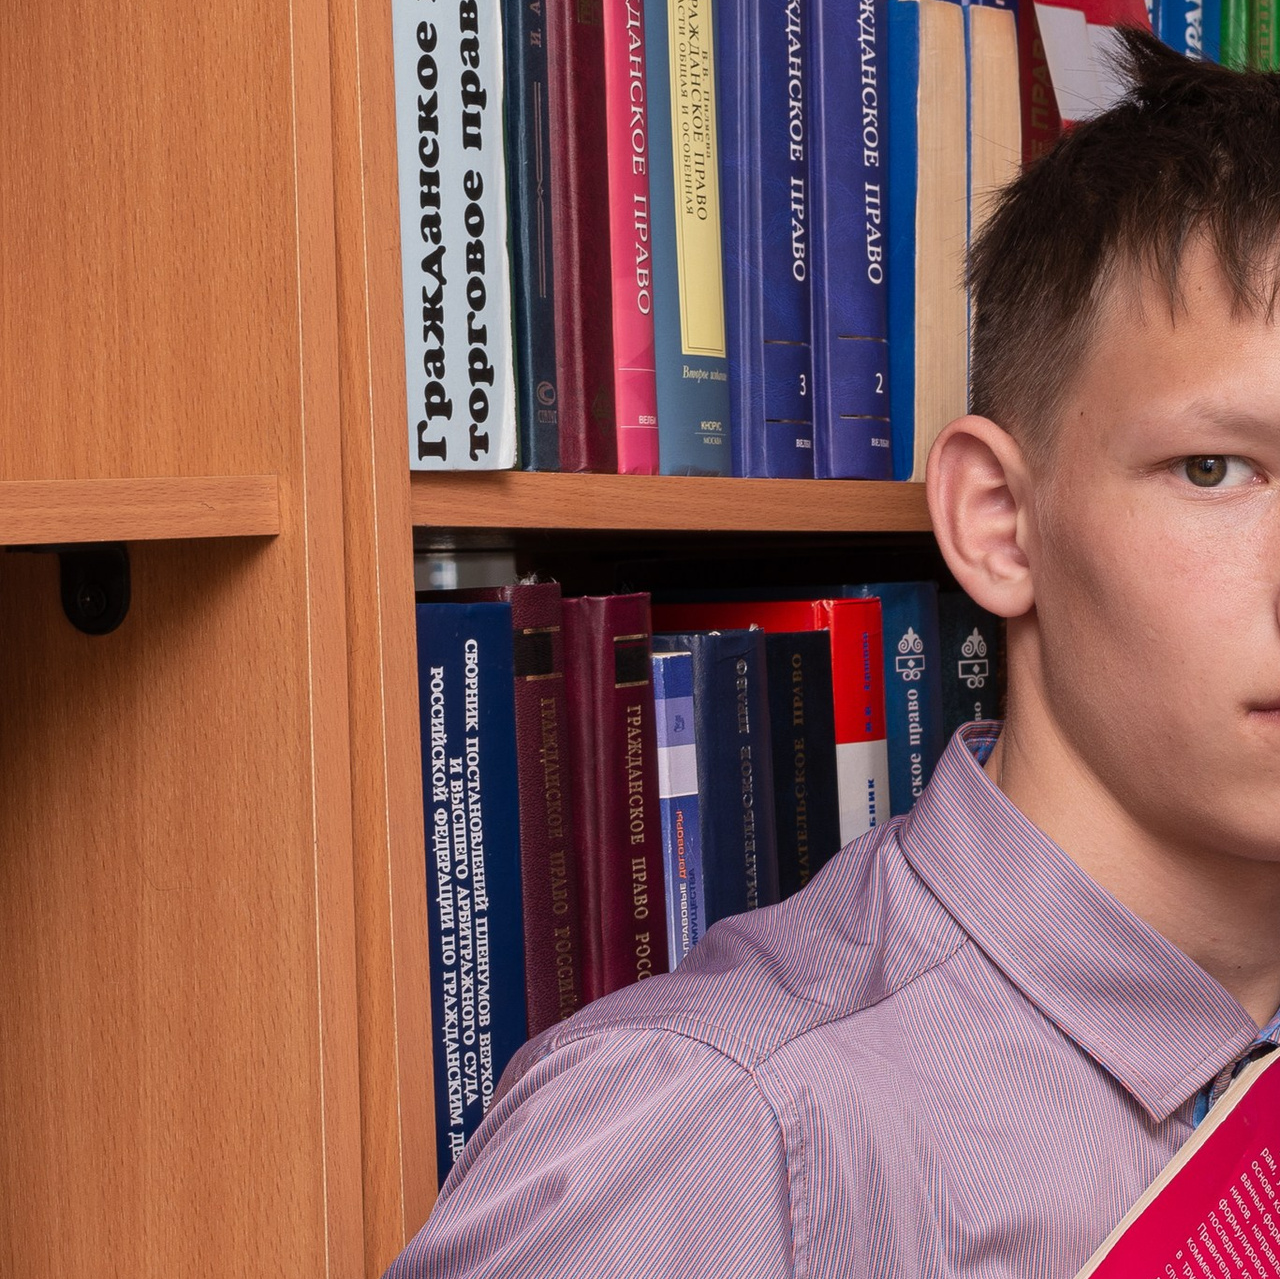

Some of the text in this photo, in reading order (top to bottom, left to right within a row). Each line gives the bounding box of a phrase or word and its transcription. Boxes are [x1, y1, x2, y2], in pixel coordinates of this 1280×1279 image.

[530, 27, 542, 48] И.
[679, 42, 688, 98] ОБЩАЯ
[681, 105, 689, 115] И
[682, 121, 694, 215] ОСОБЕННАЯ
[694, 152, 708, 221] ПРАВО
[416, 20, 452, 462] Гражданское
[633, 193, 650, 314] ПРАВО
[790, 176, 806, 282] ПРАВО
[864, 181, 883, 285] ПРАВО
[462, 169, 495, 462] торговое
[799, 373, 807, 396] 3
[875, 372, 884, 394] 2
[464, 638, 479, 732] СБОРНИК
[736, 659, 750, 734] ПРАВО
[791, 653, 804, 726] ПРАВО
[906, 688, 923, 746] право
[534, 695, 566, 839] ГРАЖДАНСКОЕ
[625, 704, 649, 920] ГРАЖДАНСКОЕ ПРАВО
[465, 736, 490, 913] ПОСТАНОВЛЕНИЙ
[430, 665, 464, 1127] РОССИЙСКОЙ ФЕДЕРАЦИИ ПО ГРАЖДАНСКИМ
[548, 849, 569, 917] ПРАВО
[675, 810, 690, 953] -ПРАВОВЫЕ ДОГОВОРЫ
[449, 756, 479, 1107] И ВЫСШЕГО АРБИТРАЖНОГО СУДА
[475, 916, 491, 1027] ПЛЕНУМОВ
[1251, 1160, 1276, 1200] основе
[1259, 1147, 1278, 1176] рам,
